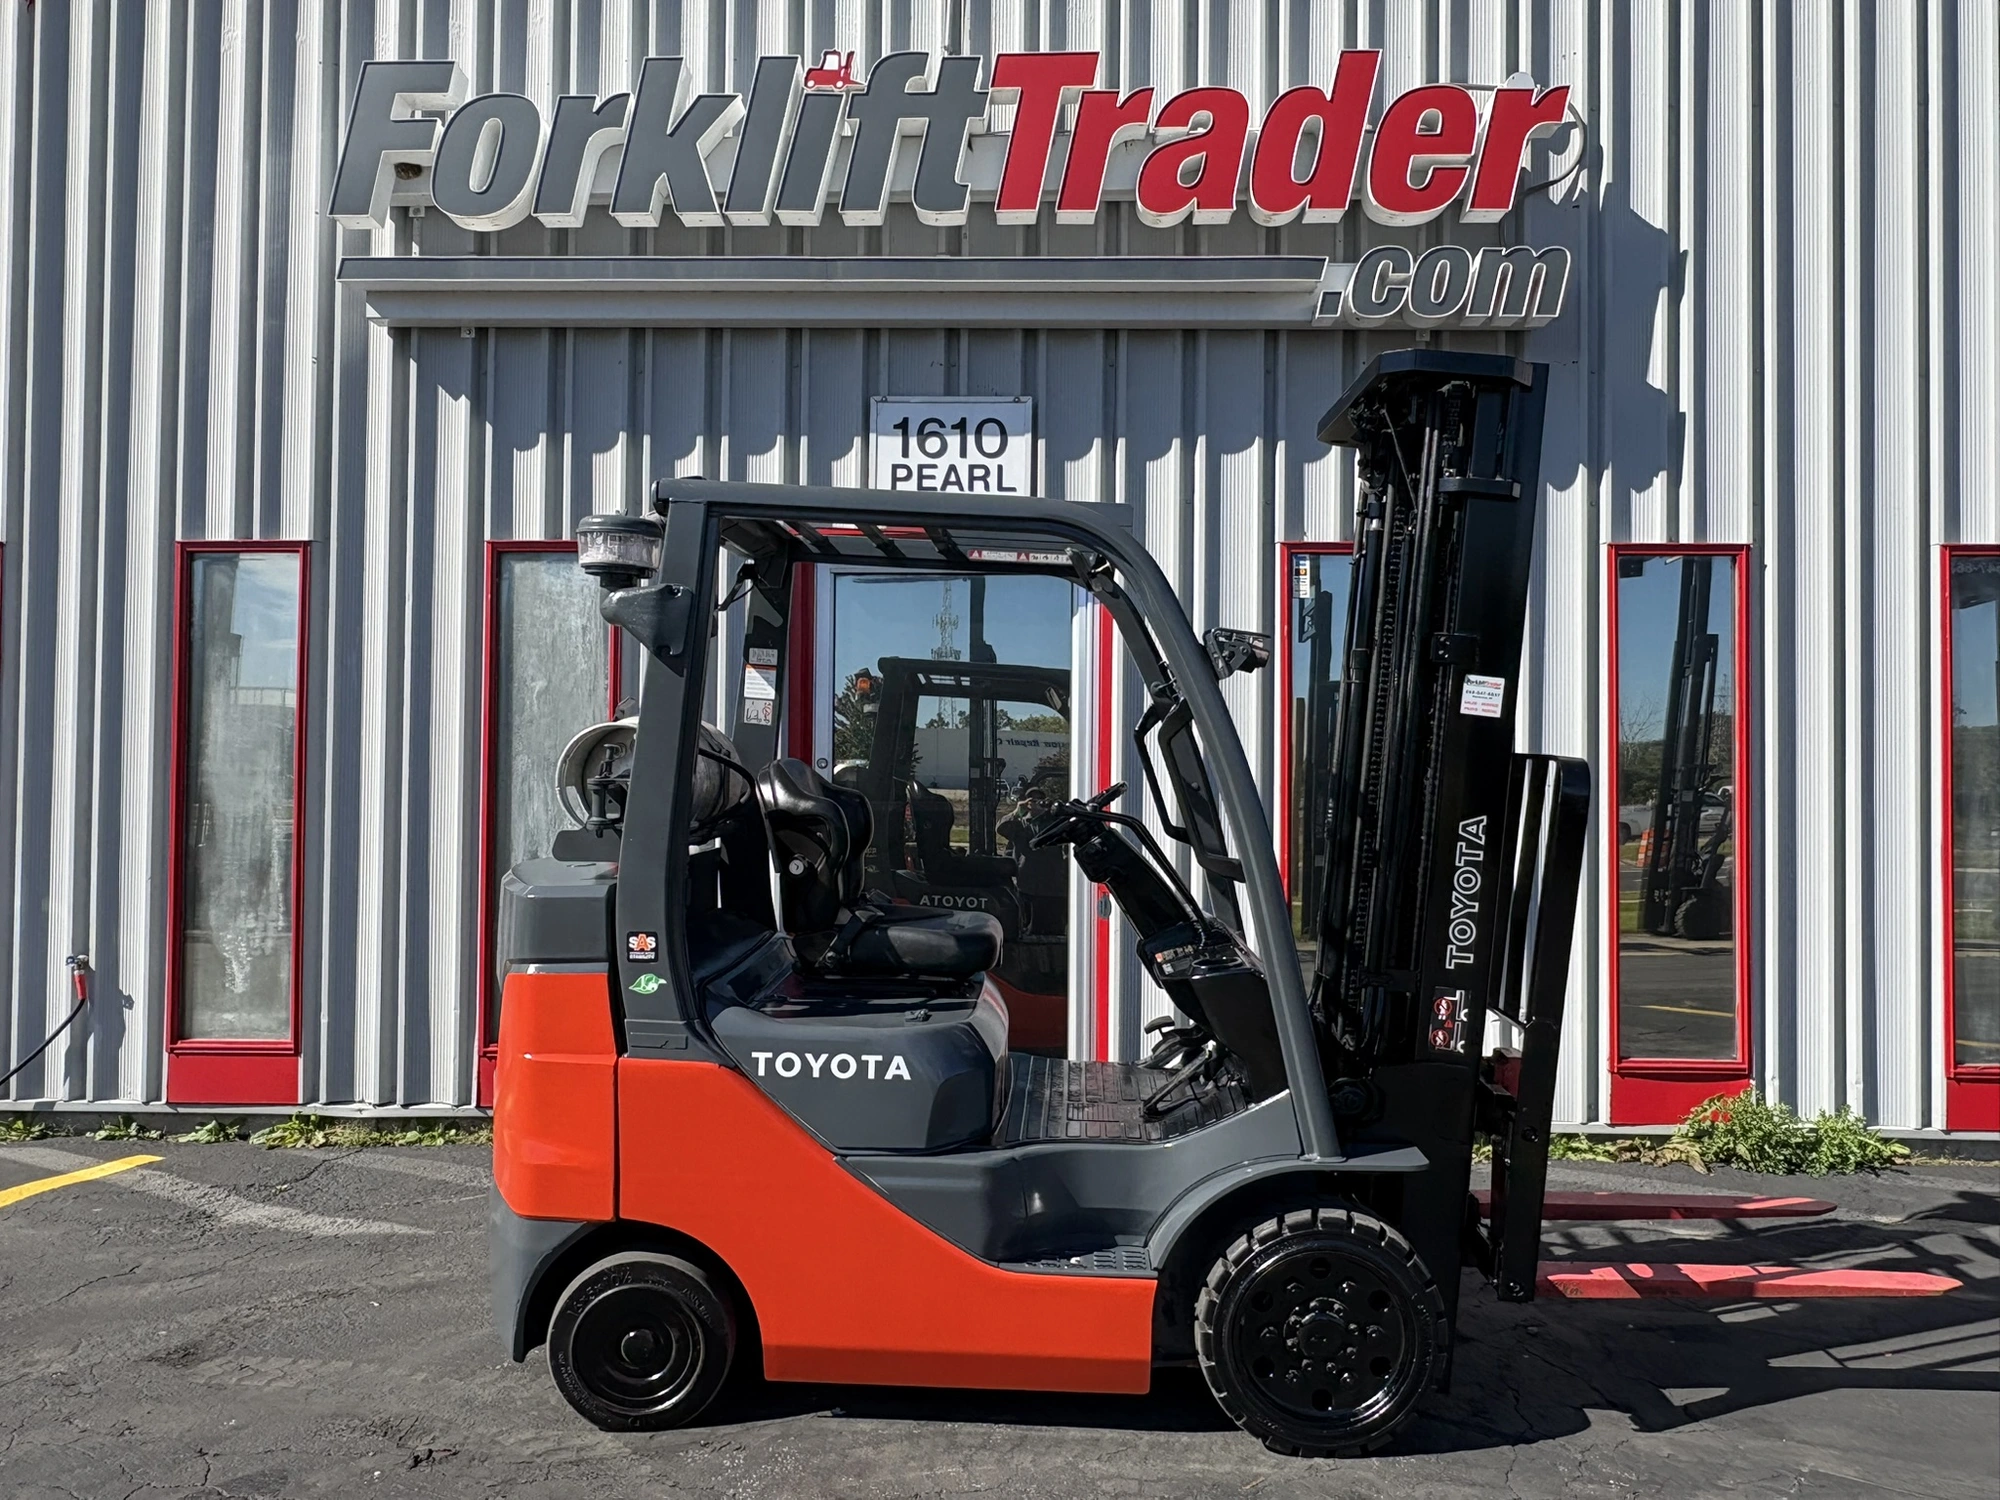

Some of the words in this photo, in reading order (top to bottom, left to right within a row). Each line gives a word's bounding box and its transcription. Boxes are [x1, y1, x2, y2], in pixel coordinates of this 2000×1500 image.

[1314, 246, 1571, 318] .com
[892, 417, 1009, 459] 1610
[891, 463, 1017, 492] PEARL
[1446, 815, 1487, 969] TOYOTA
[628, 933, 657, 951] SAS
[751, 1051, 912, 1081] TOYOTA
